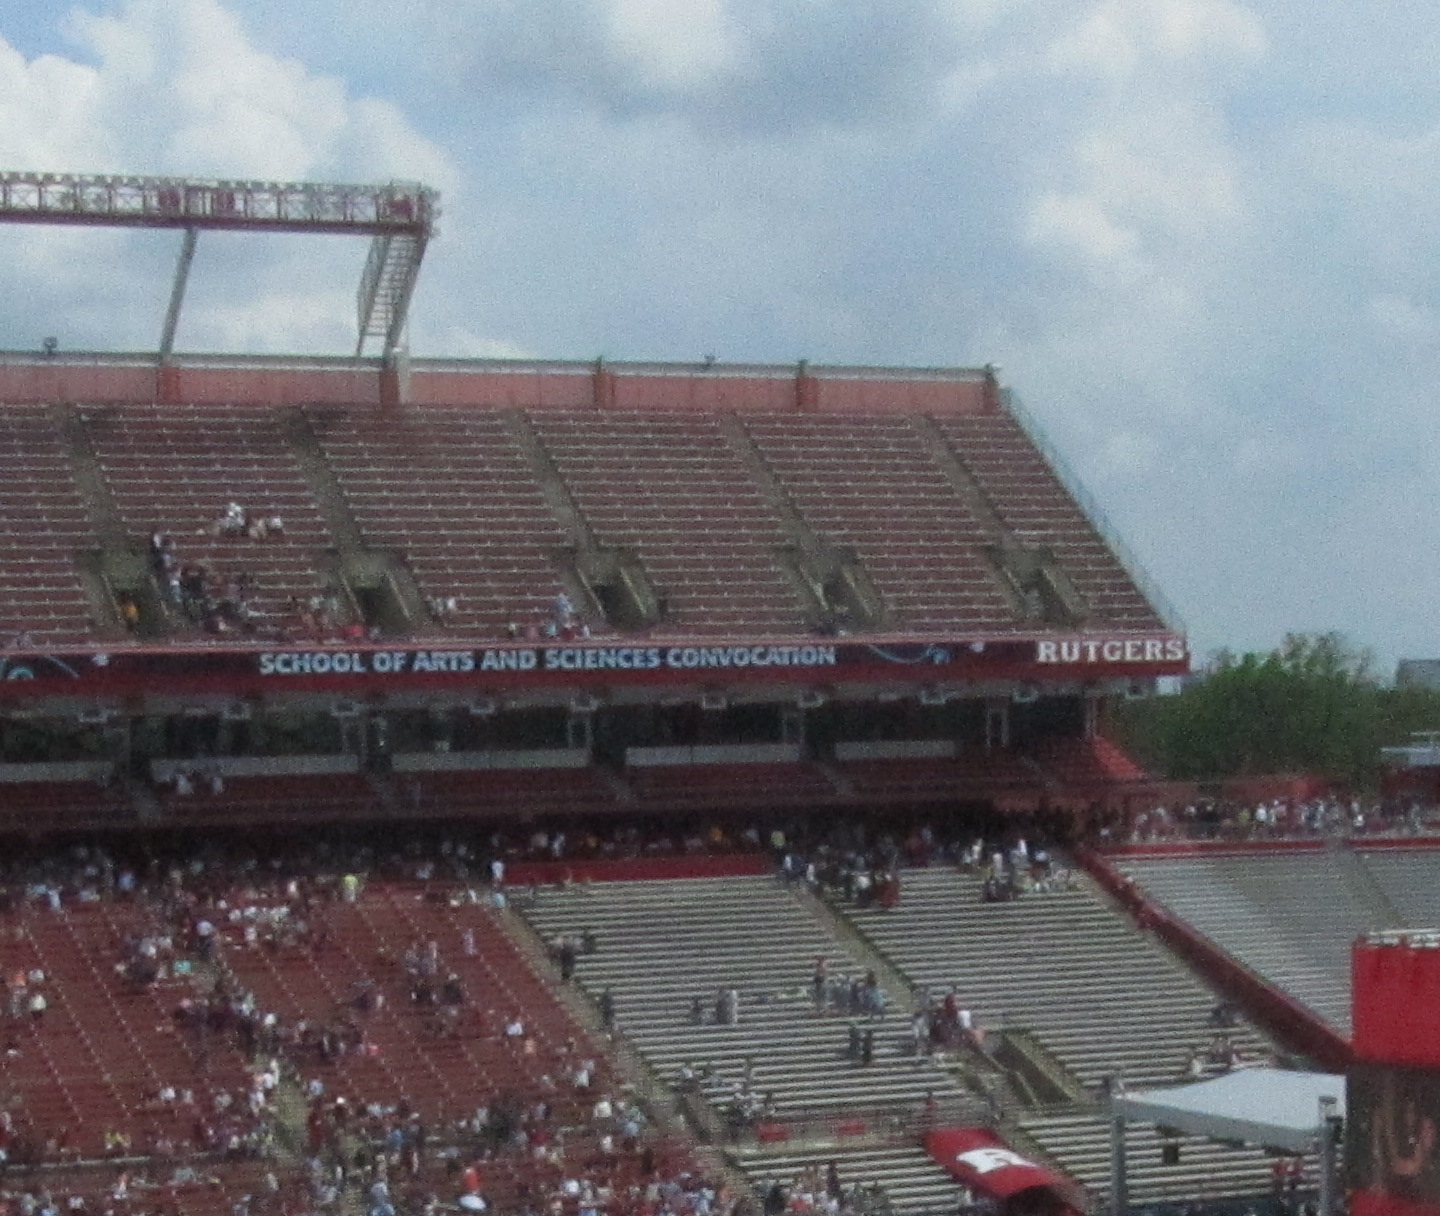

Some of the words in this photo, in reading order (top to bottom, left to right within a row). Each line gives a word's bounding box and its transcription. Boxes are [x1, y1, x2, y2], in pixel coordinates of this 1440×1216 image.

[261, 651, 364, 673] SCHOOL
[374, 651, 407, 671] OF
[413, 650, 473, 670] ARTS
[482, 649, 537, 669] AND
[546, 647, 660, 669] SCIENCES
[668, 645, 835, 666] CONVOCATION
[1038, 639, 1185, 662] RUTGERS
